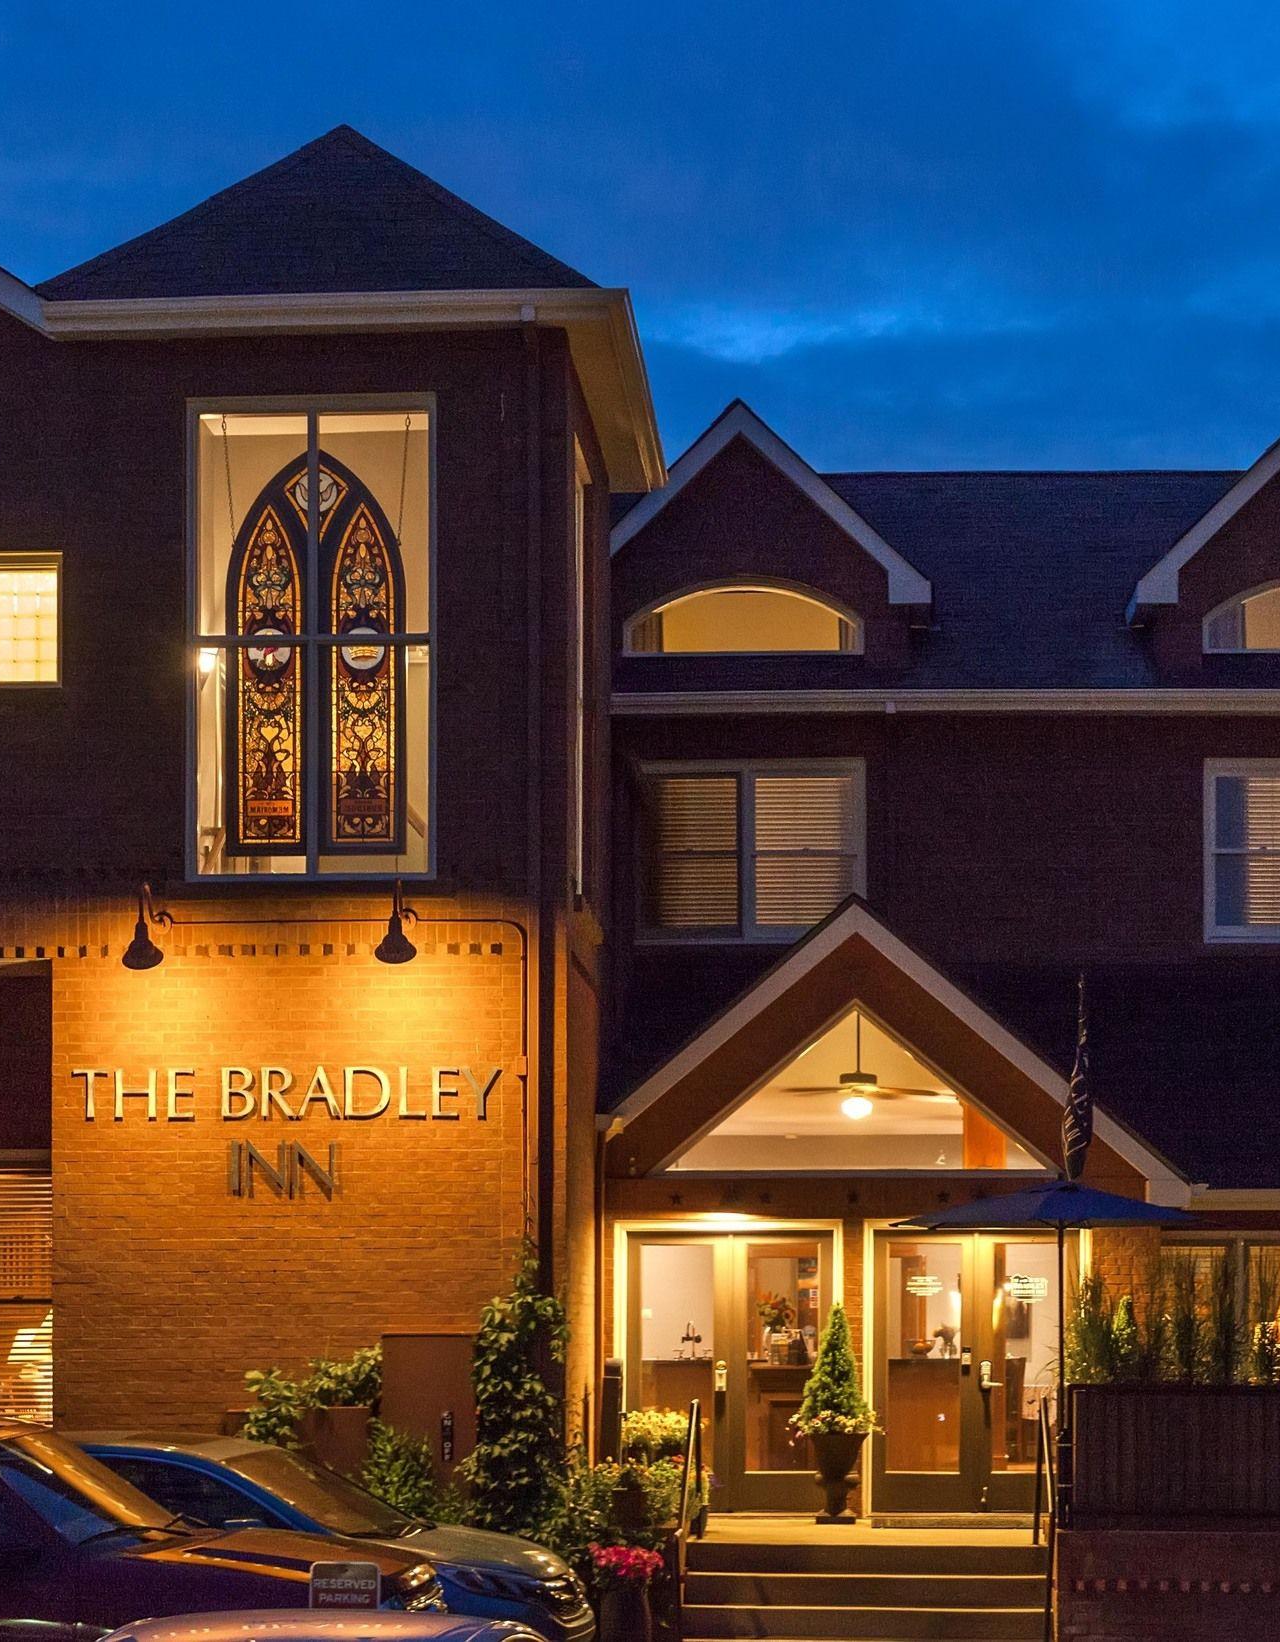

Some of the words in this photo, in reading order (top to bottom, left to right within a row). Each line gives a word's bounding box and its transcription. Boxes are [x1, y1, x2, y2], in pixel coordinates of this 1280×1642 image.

[71, 1068, 195, 1122] THE
[221, 1065, 503, 1121] BRADLEY
[230, 1138, 341, 1200] INN
[313, 1578, 375, 1589] RESERVED
[320, 1593, 370, 1603] PARKING
